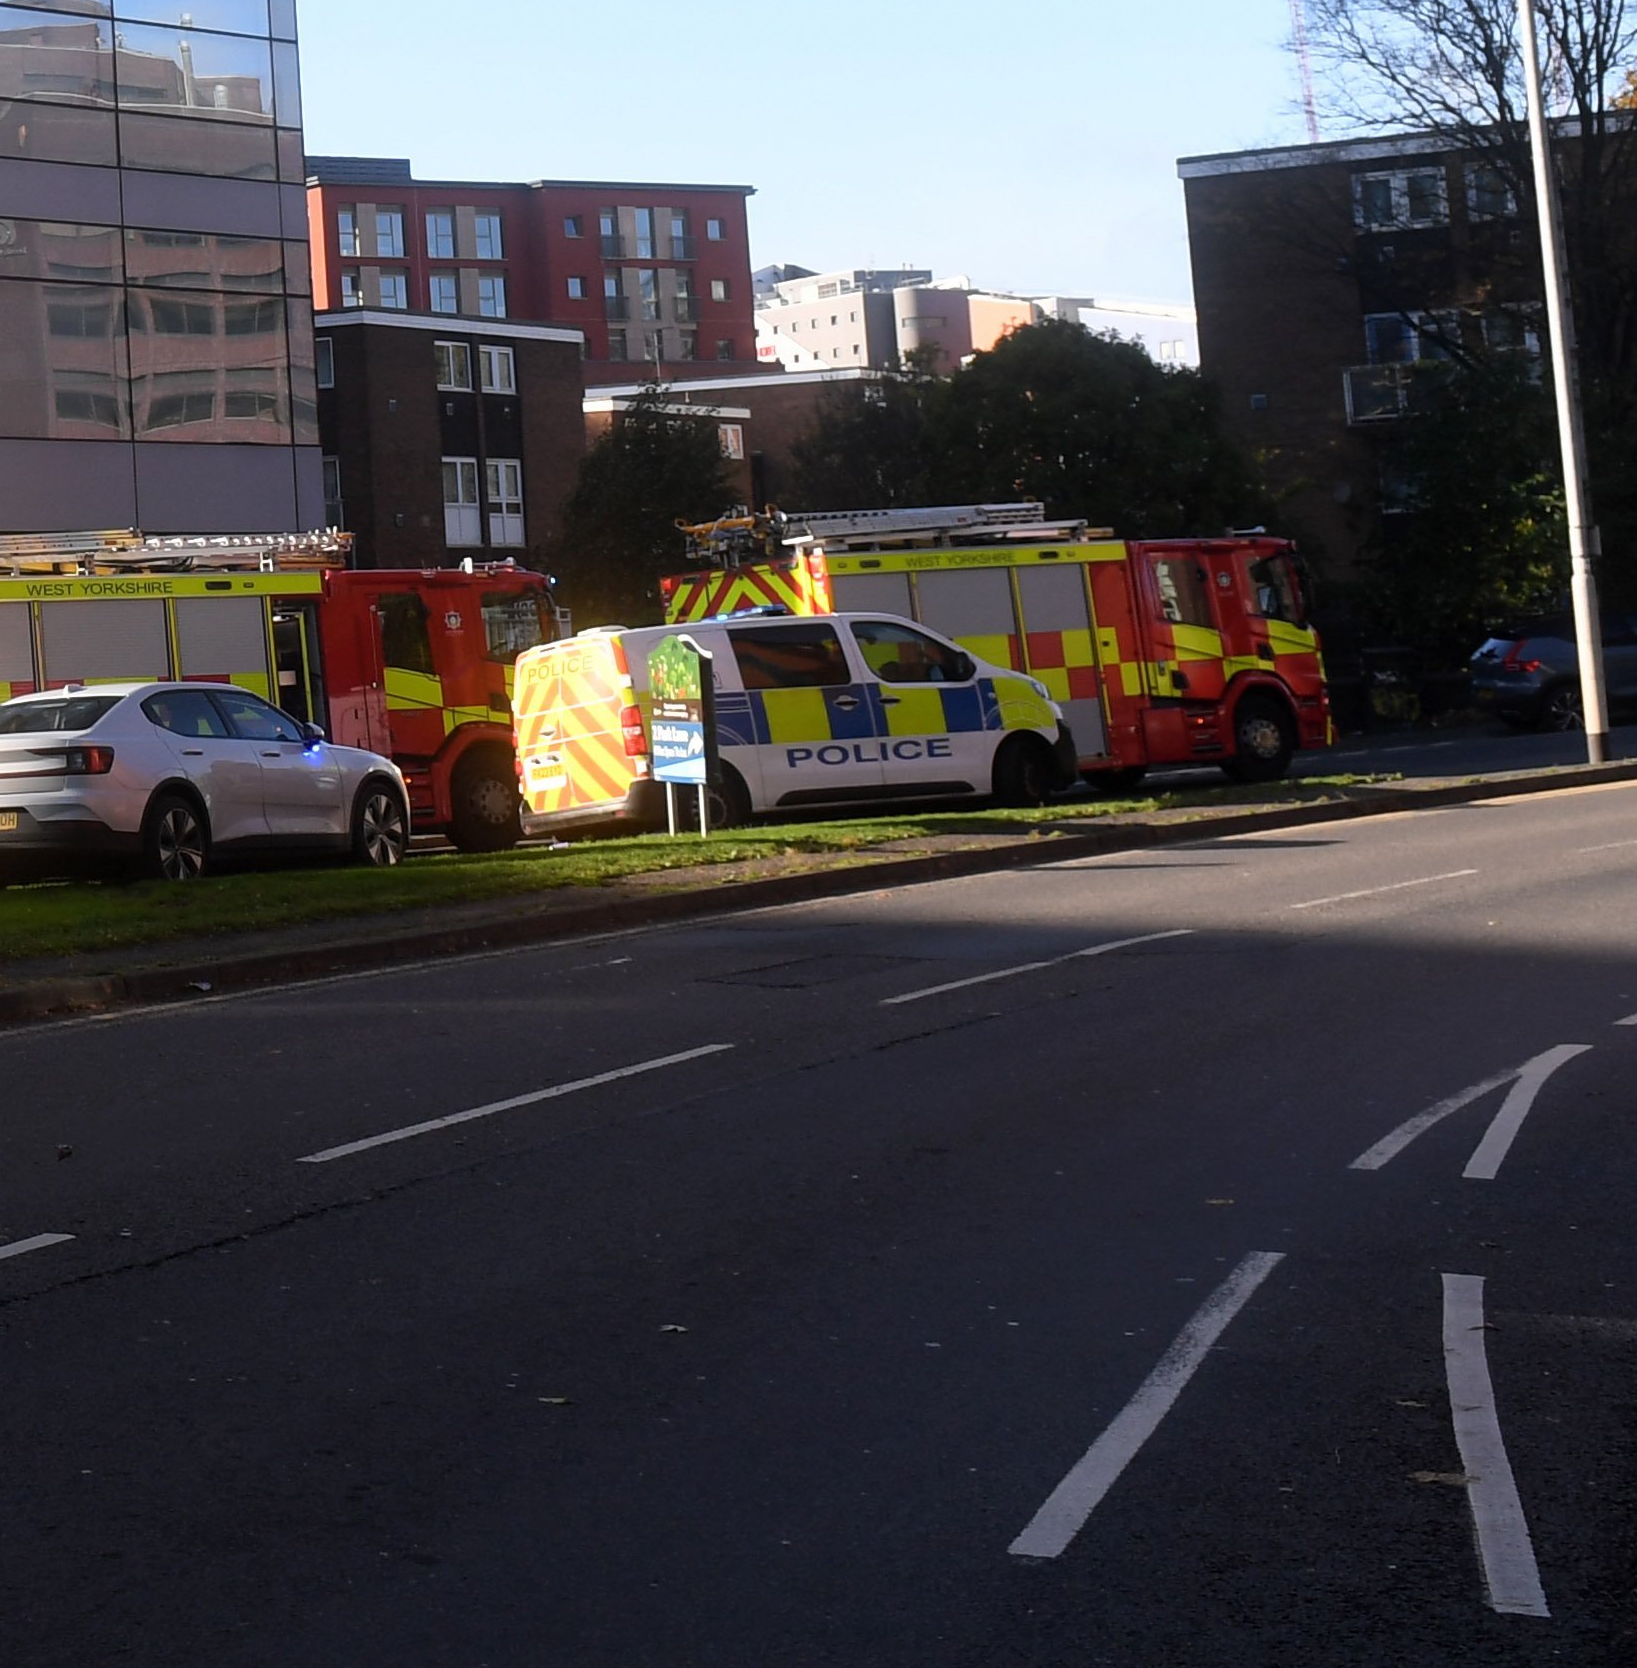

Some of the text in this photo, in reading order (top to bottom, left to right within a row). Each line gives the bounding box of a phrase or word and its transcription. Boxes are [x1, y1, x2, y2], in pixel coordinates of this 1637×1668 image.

[905, 556, 940, 568] WEST
[27, 581, 173, 596] WEST YORKSHIRE
[528, 655, 593, 683] POLICE
[786, 738, 952, 768] POLICE
